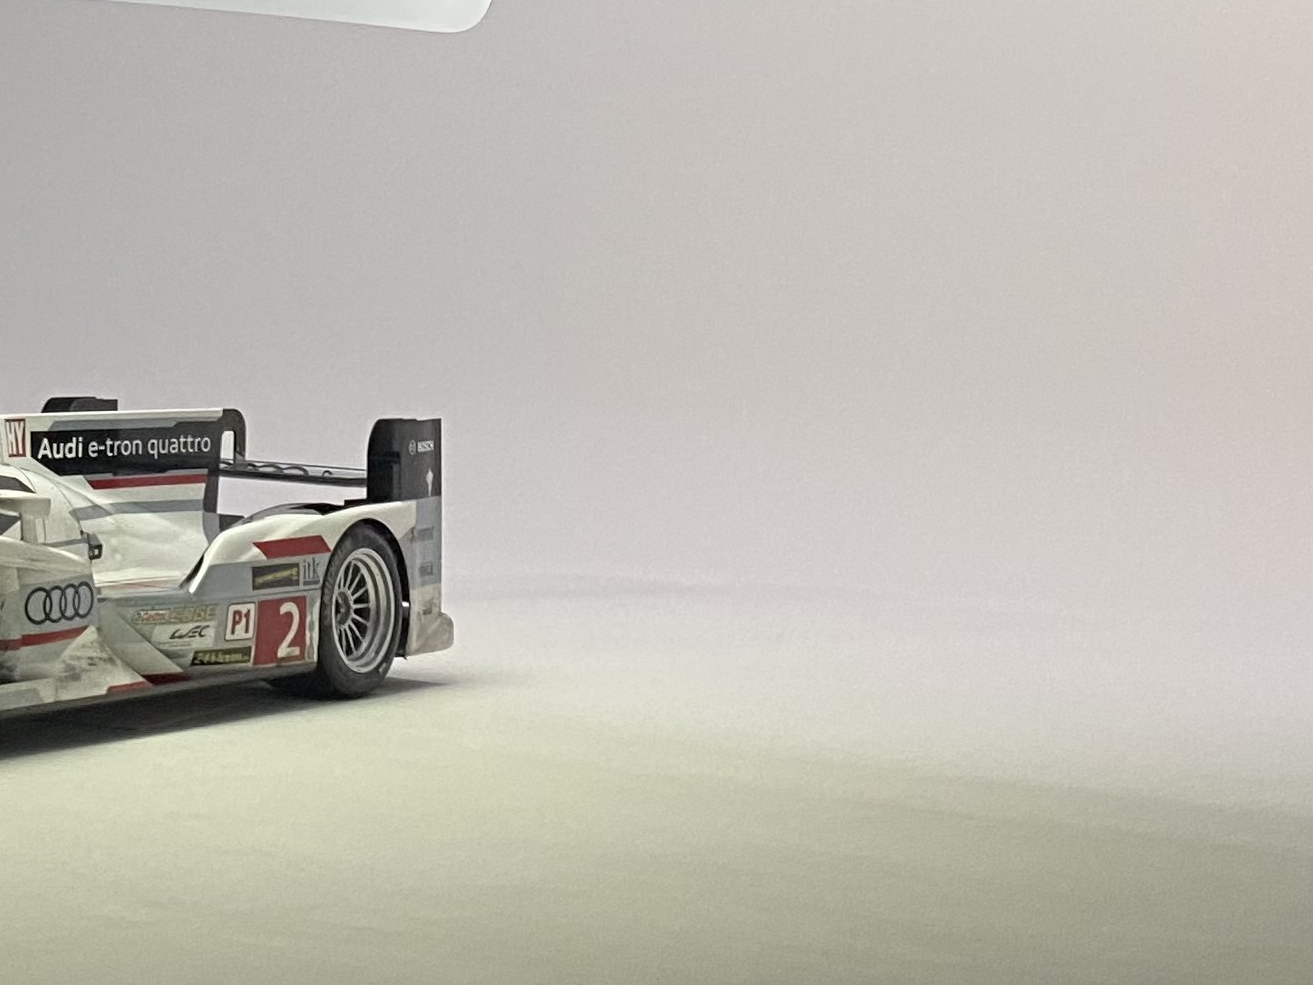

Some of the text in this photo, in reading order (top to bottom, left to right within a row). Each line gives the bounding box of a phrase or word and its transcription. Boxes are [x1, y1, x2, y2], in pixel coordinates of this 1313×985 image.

[6, 419, 25, 456] HY
[37, 435, 212, 460] Audi e-tron quattro
[231, 607, 251, 636] P1
[277, 601, 301, 659] 2
